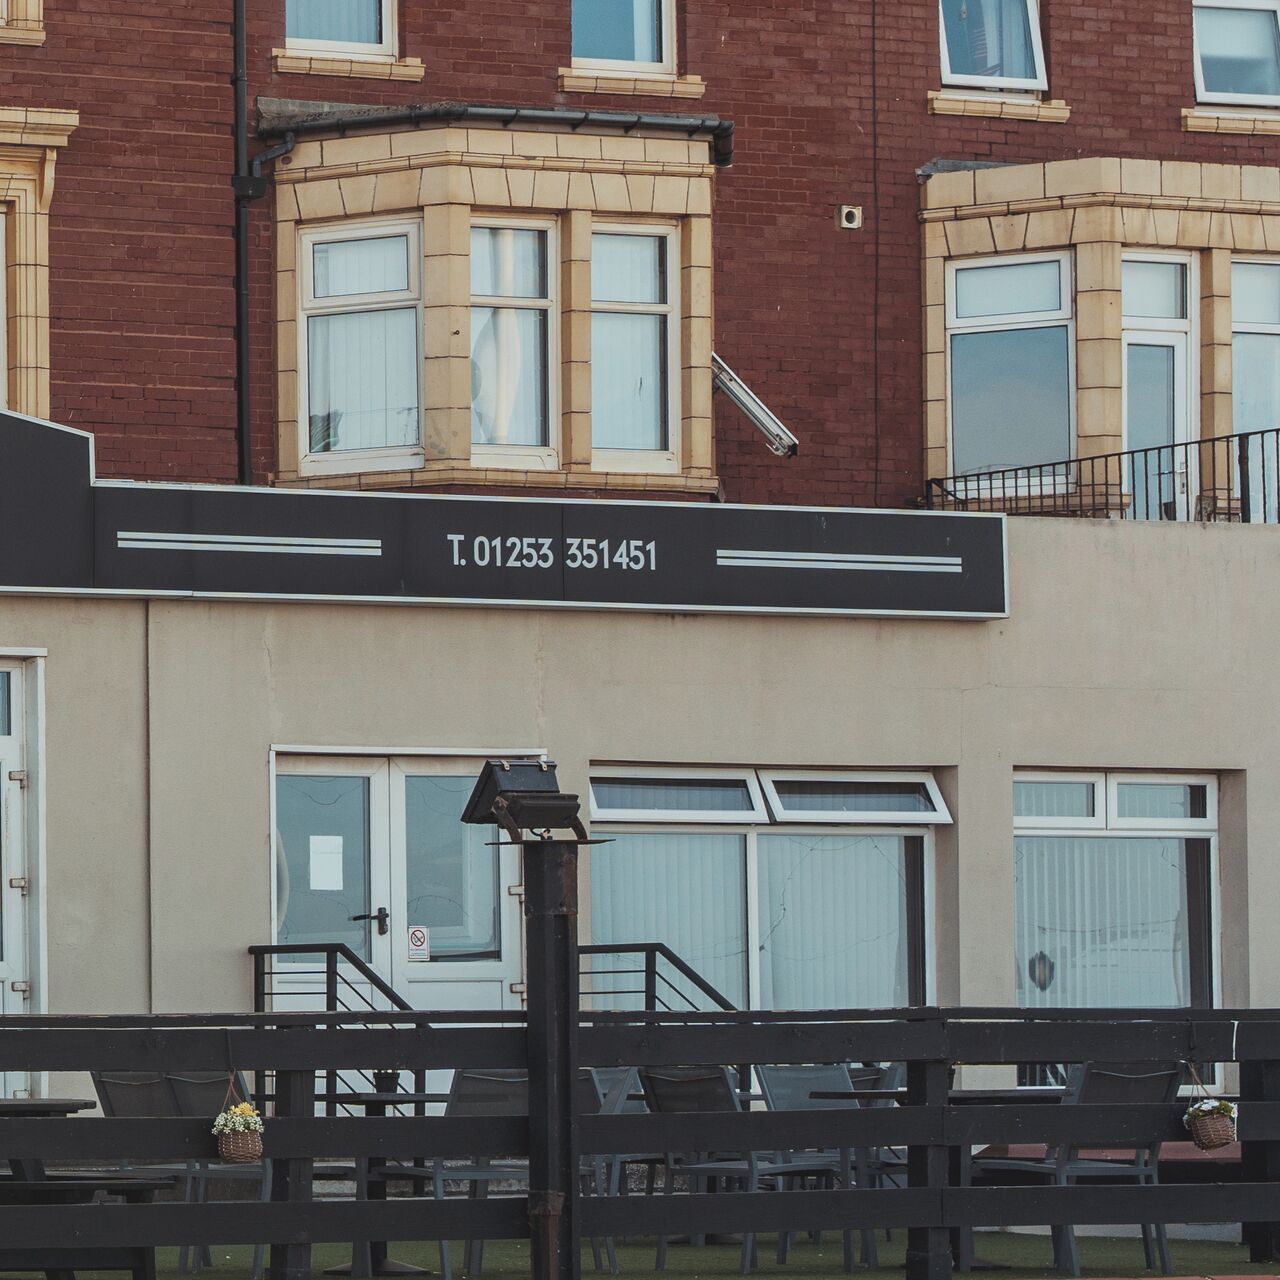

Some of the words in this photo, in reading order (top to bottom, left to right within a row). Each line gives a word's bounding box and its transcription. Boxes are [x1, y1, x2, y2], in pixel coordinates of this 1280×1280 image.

[446, 533, 467, 567] T.
[473, 535, 555, 569] 01253
[565, 537, 657, 571] 351451
